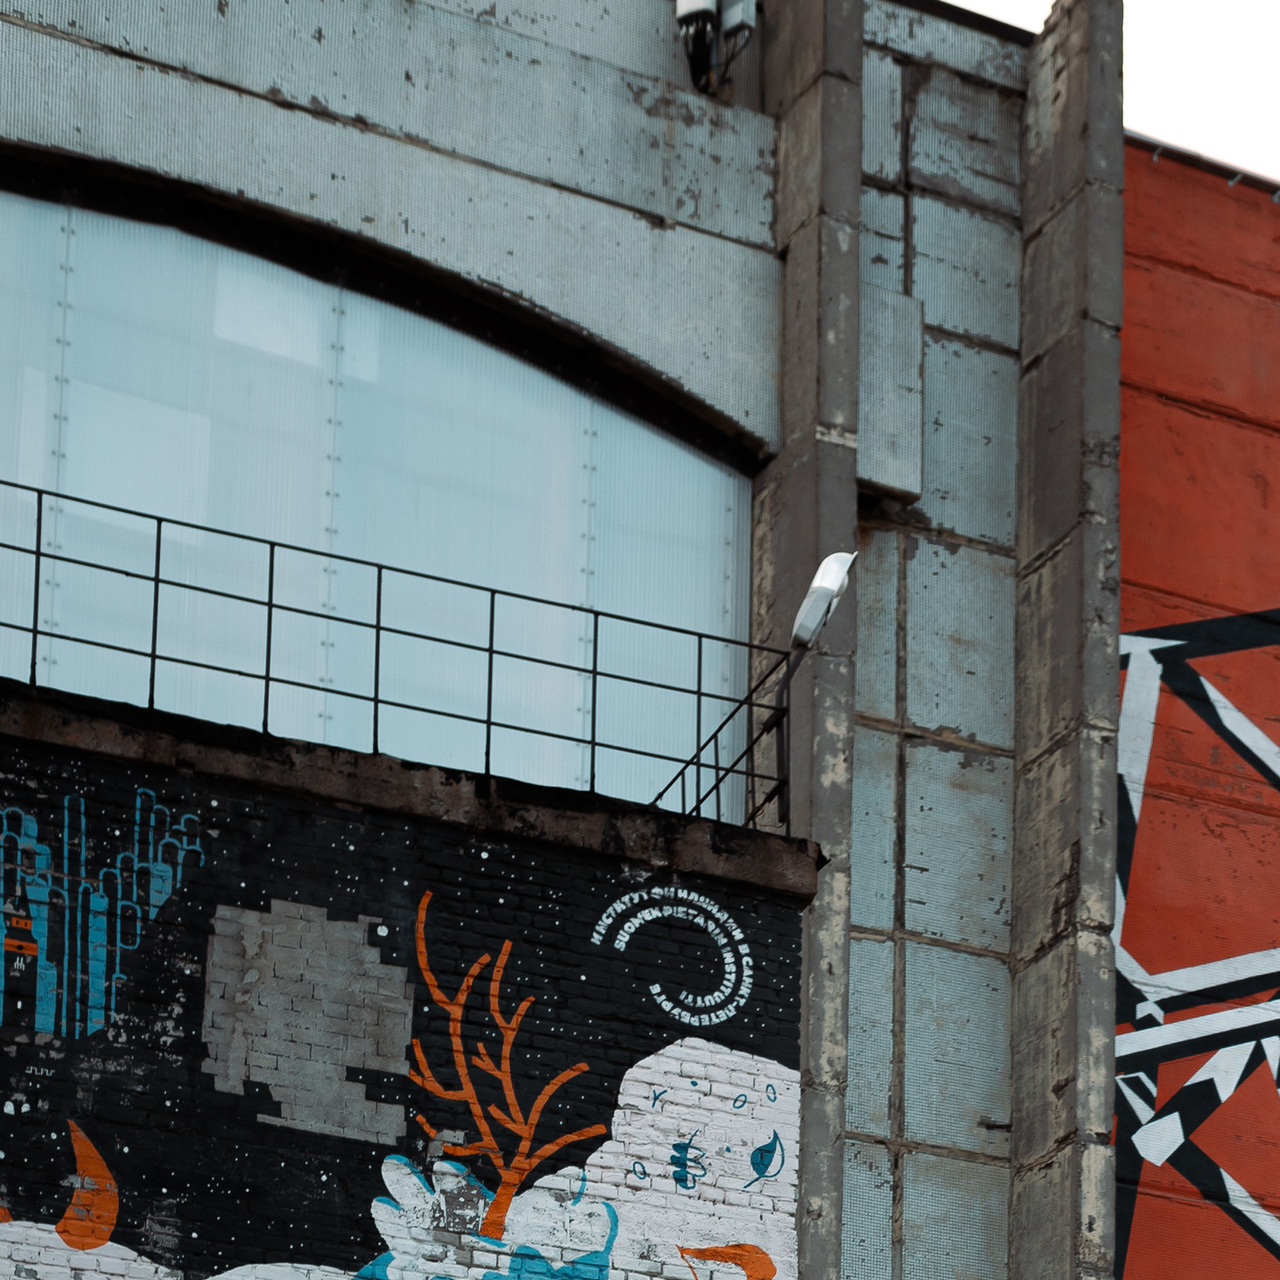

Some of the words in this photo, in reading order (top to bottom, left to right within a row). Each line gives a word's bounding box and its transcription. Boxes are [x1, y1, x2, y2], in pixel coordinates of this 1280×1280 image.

[590, 890, 649, 945] ИНСТИТУТ
[738, 943, 750, 955] В
[614, 906, 662, 951] SUOMEN
[679, 947, 736, 1007] INSTITUUTTI
